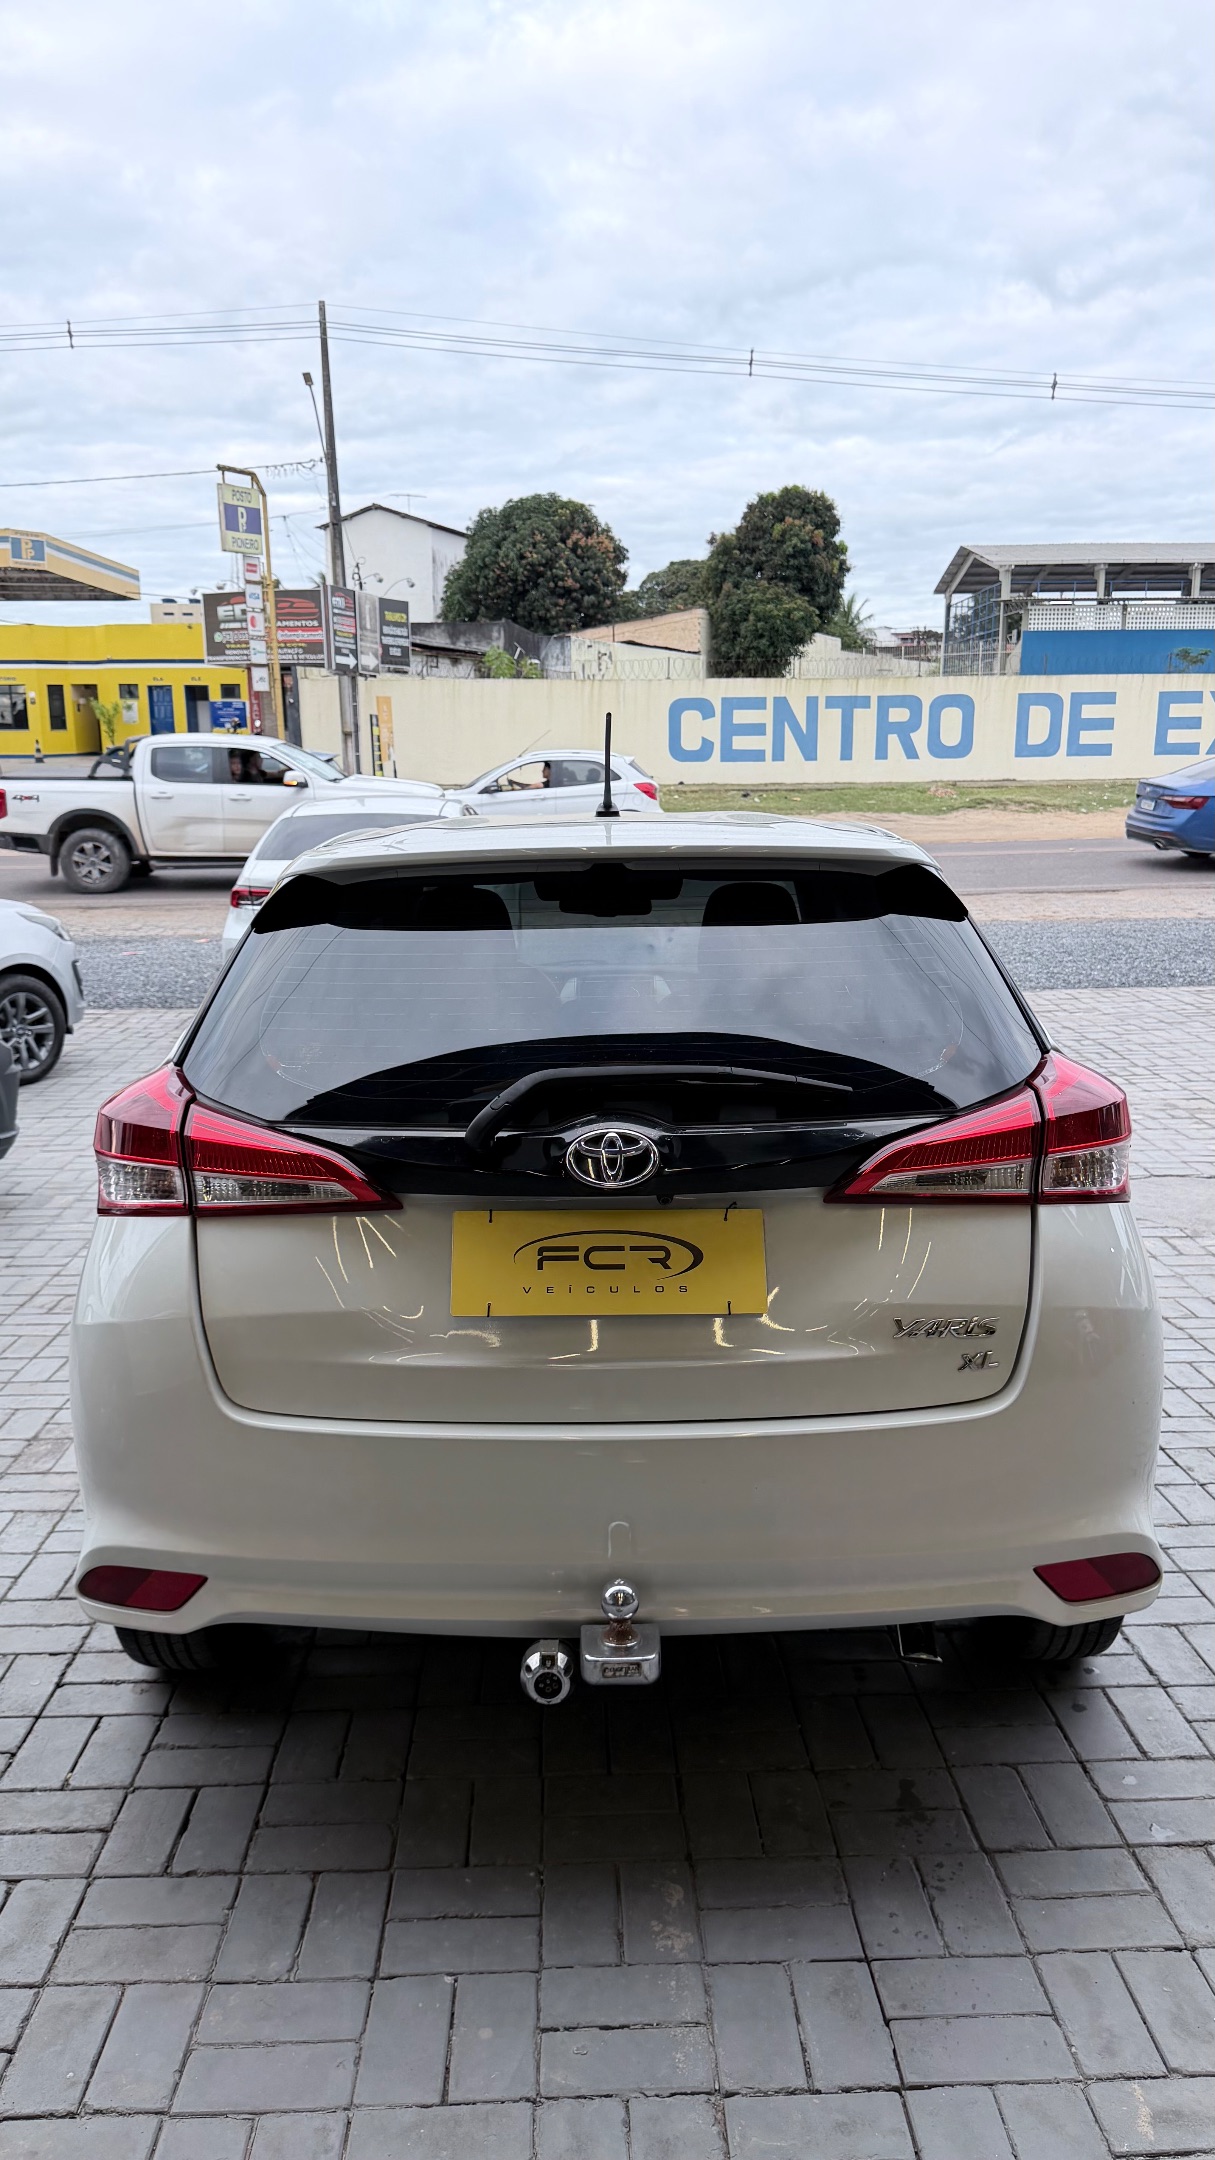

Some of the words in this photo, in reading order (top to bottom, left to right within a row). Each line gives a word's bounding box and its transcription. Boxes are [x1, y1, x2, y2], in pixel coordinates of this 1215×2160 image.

[232, 489, 252, 504] POSTO
[231, 536, 259, 551] PIONEIRO
[667, 693, 975, 763] CENTRO
[1014, 692, 1117, 758] DE
[1154, 690, 1215, 756] E
[537, 1245, 672, 1271] FCR
[522, 1284, 688, 1294] VEÍCULOS
[893, 1316, 1000, 1338] YARIS
[958, 1350, 999, 1371] XL
